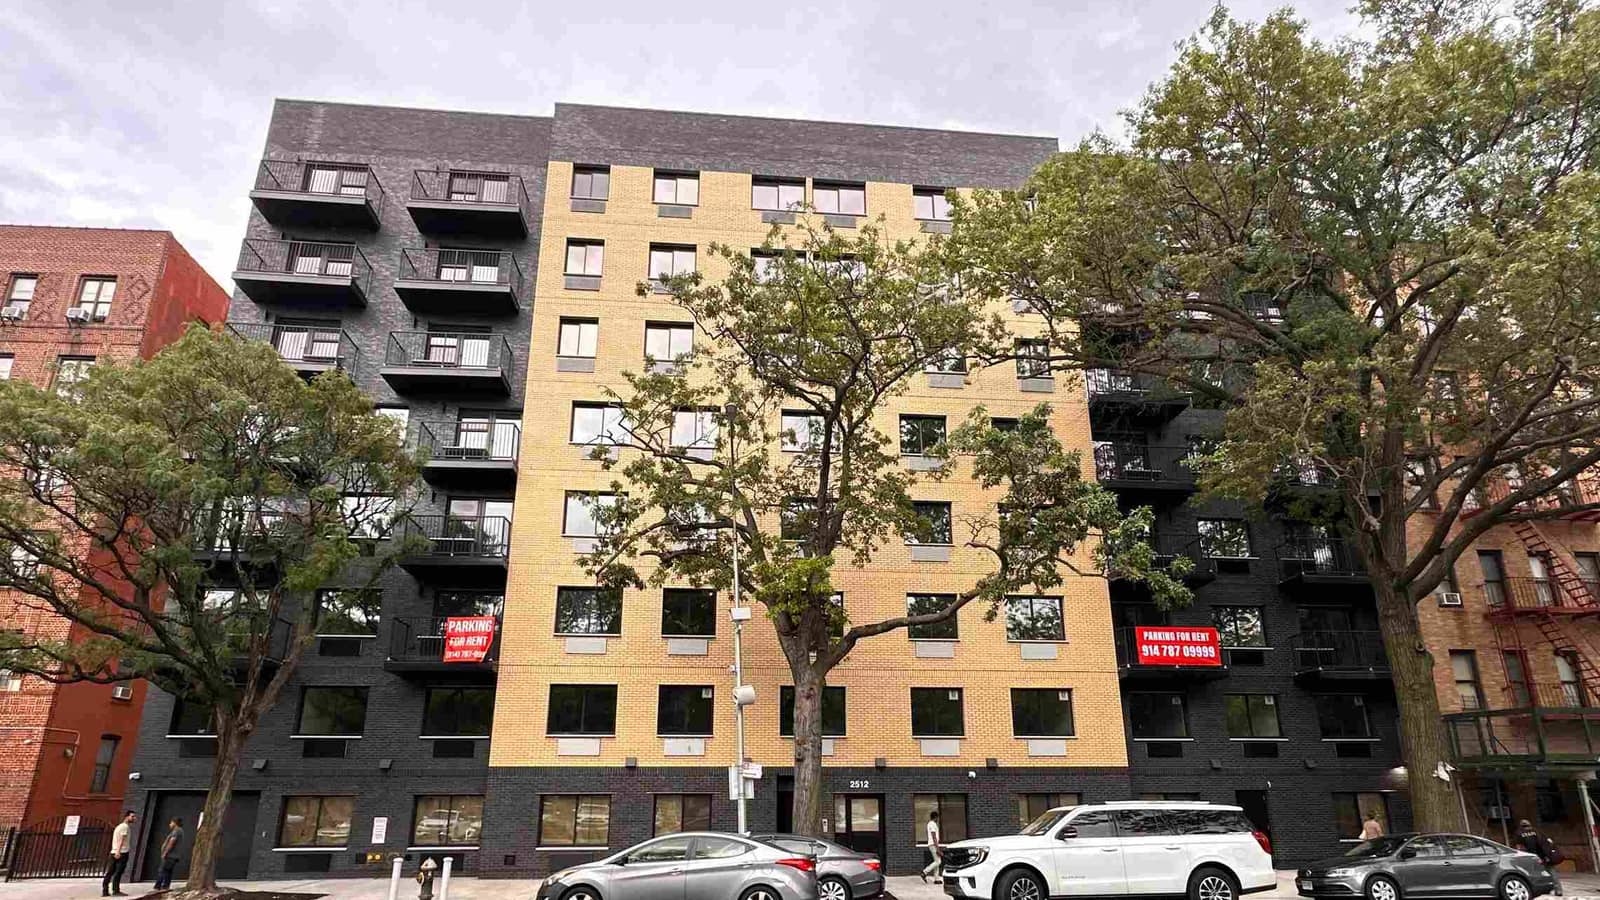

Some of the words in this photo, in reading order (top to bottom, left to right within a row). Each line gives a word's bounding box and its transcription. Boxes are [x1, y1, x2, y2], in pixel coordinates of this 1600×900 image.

[448, 620, 493, 633] PARKING
[448, 636, 465, 647] FOR
[465, 636, 489, 647] RENT
[1143, 631, 1176, 641] PARKING
[1176, 632, 1192, 641] FOR
[1191, 632, 1210, 642] RENT
[1142, 644, 1160, 657] 914
[1161, 645, 1181, 657] 787
[1182, 645, 1216, 658] 09999
[849, 780, 870, 789] 2512
